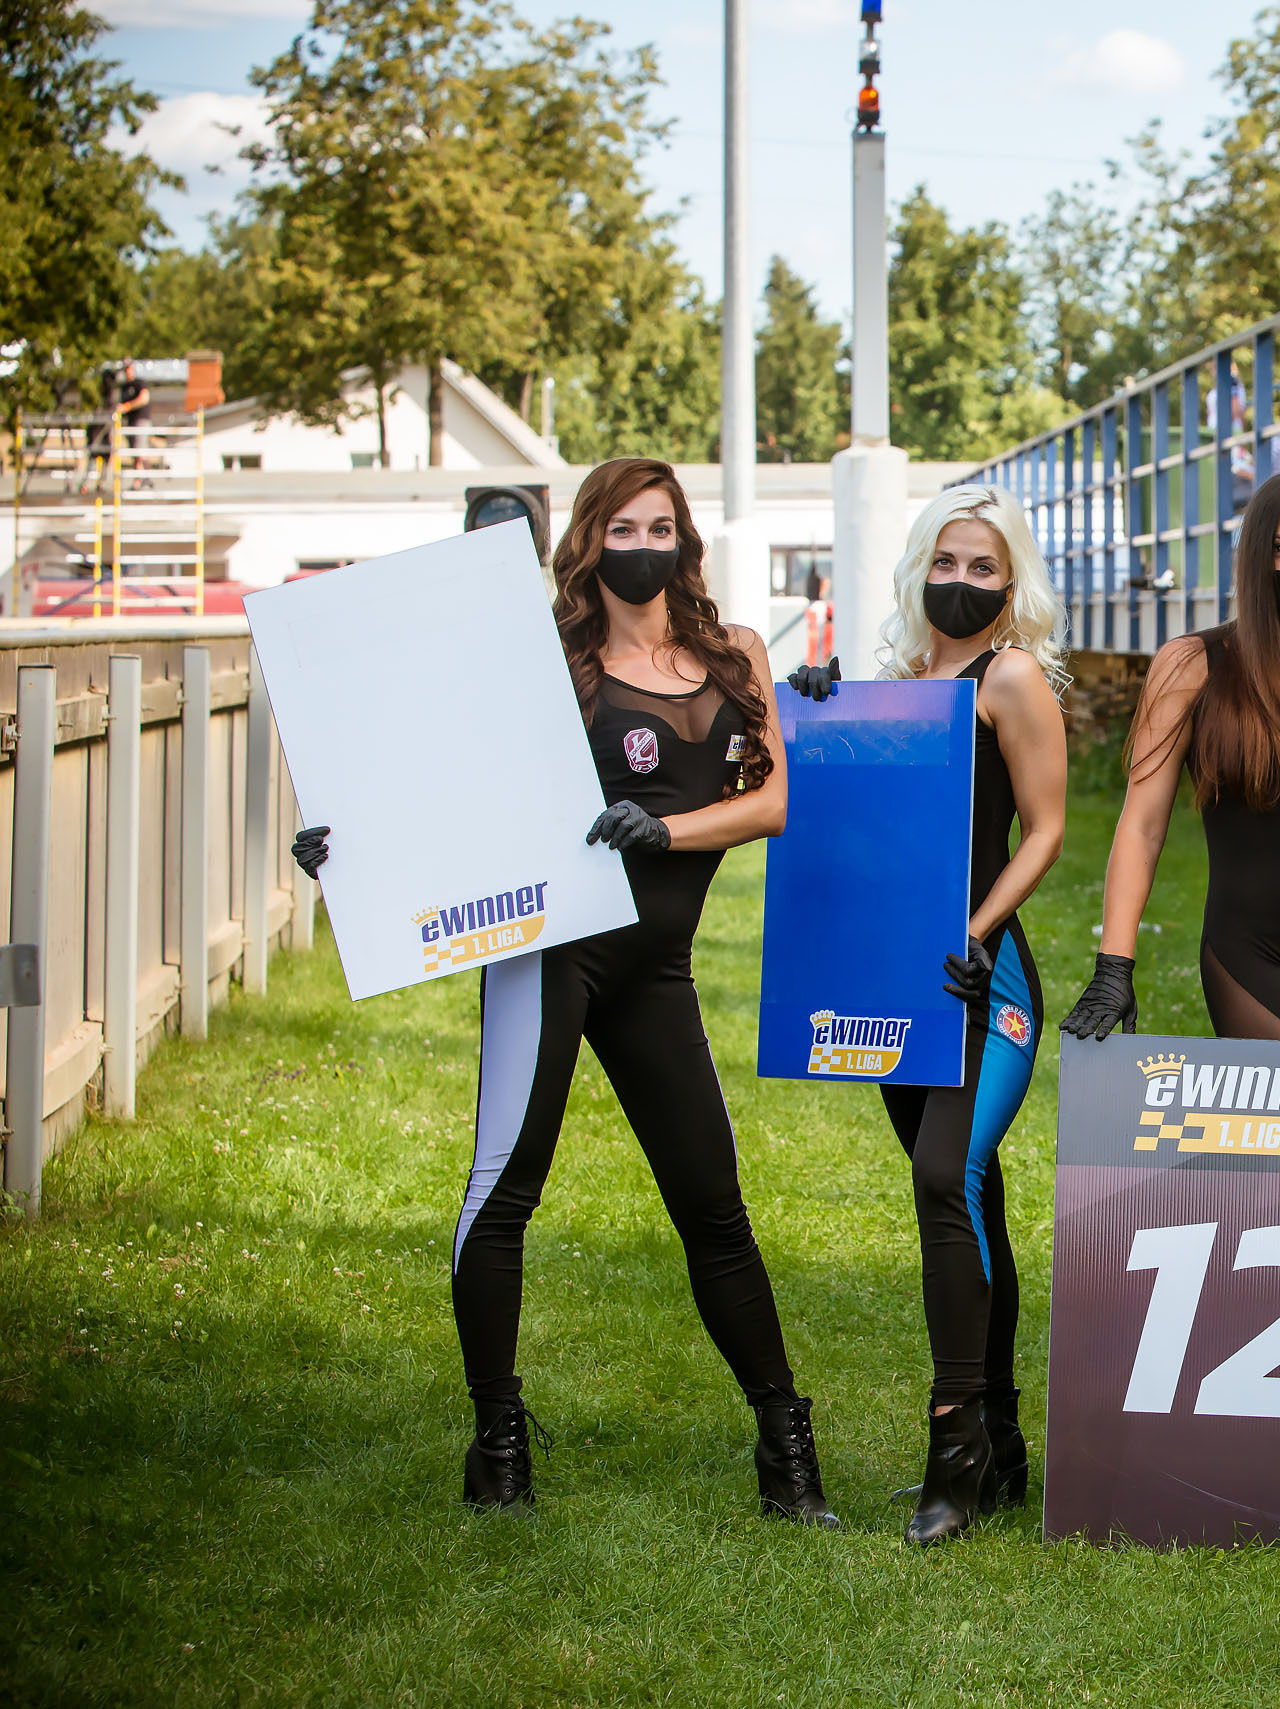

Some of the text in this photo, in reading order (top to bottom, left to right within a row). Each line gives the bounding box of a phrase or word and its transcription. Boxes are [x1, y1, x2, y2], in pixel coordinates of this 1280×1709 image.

[472, 926, 525, 955] 1. LIGA
[846, 1053, 882, 1071] 1. LIGA
[1218, 1121, 1234, 1148] 1.
